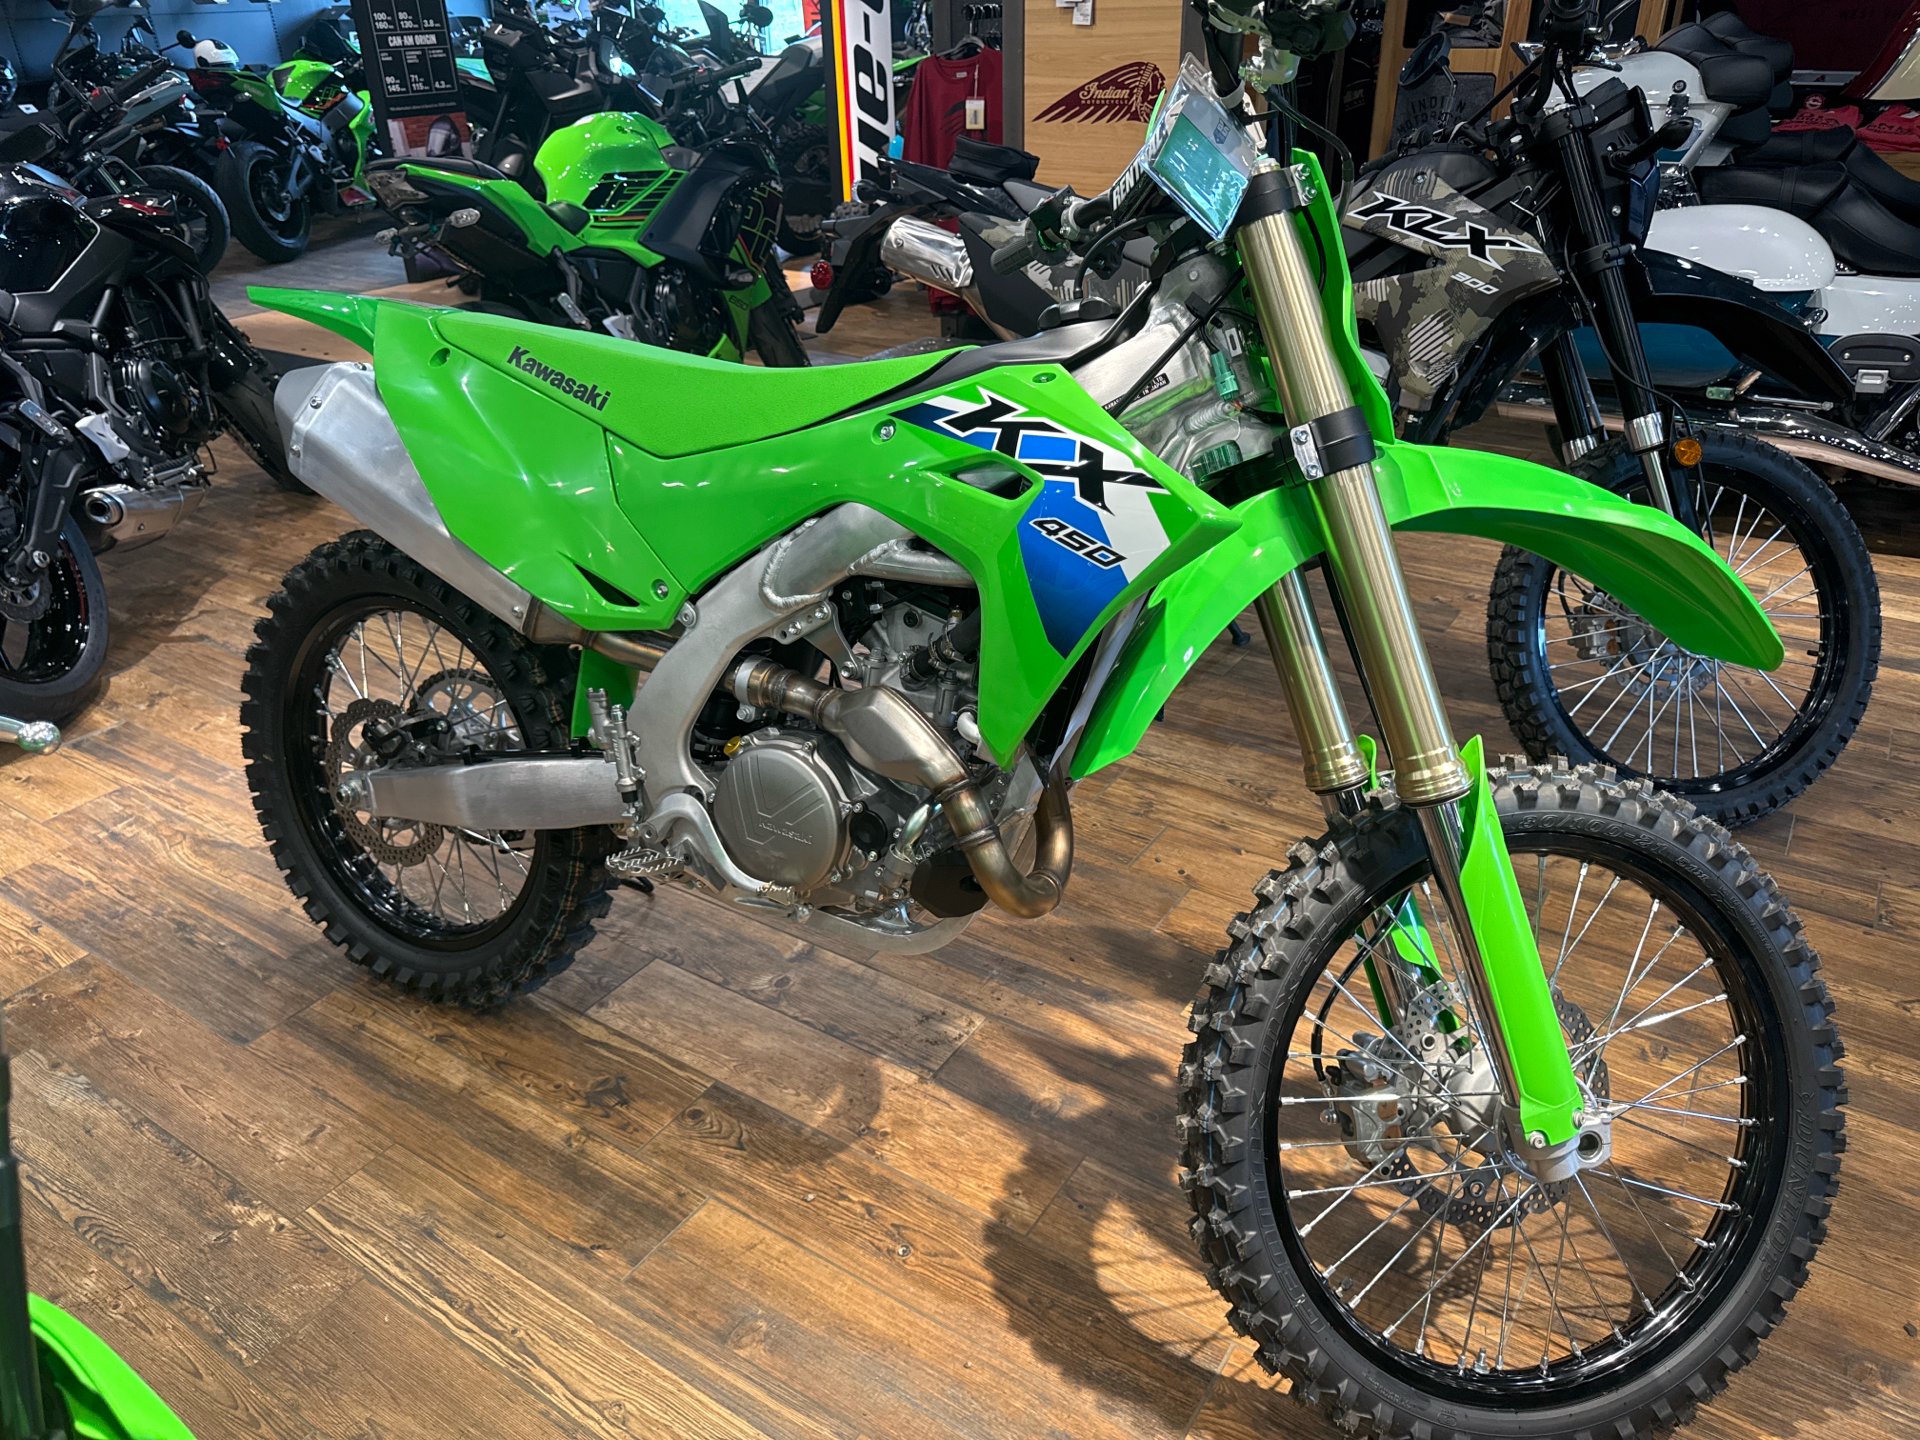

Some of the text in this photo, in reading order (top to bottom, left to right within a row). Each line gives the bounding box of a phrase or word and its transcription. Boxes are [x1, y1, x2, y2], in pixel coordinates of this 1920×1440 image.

[388, 34, 437, 47] CAN-AM ORIGIN
[1079, 82, 1129, 99] Indian
[1411, 96, 1467, 114] INDIN
[1346, 190, 1543, 272] KLX
[1451, 271, 1500, 295] 300
[507, 346, 611, 411] Kawasaki
[1151, 380, 1167, 391] JAPAN
[934, 386, 1171, 516] KX
[1029, 518, 1127, 569] 450
[1518, 814, 1710, 883] 80/100-21 51M
[1759, 1109, 1815, 1282] DUNLOP
